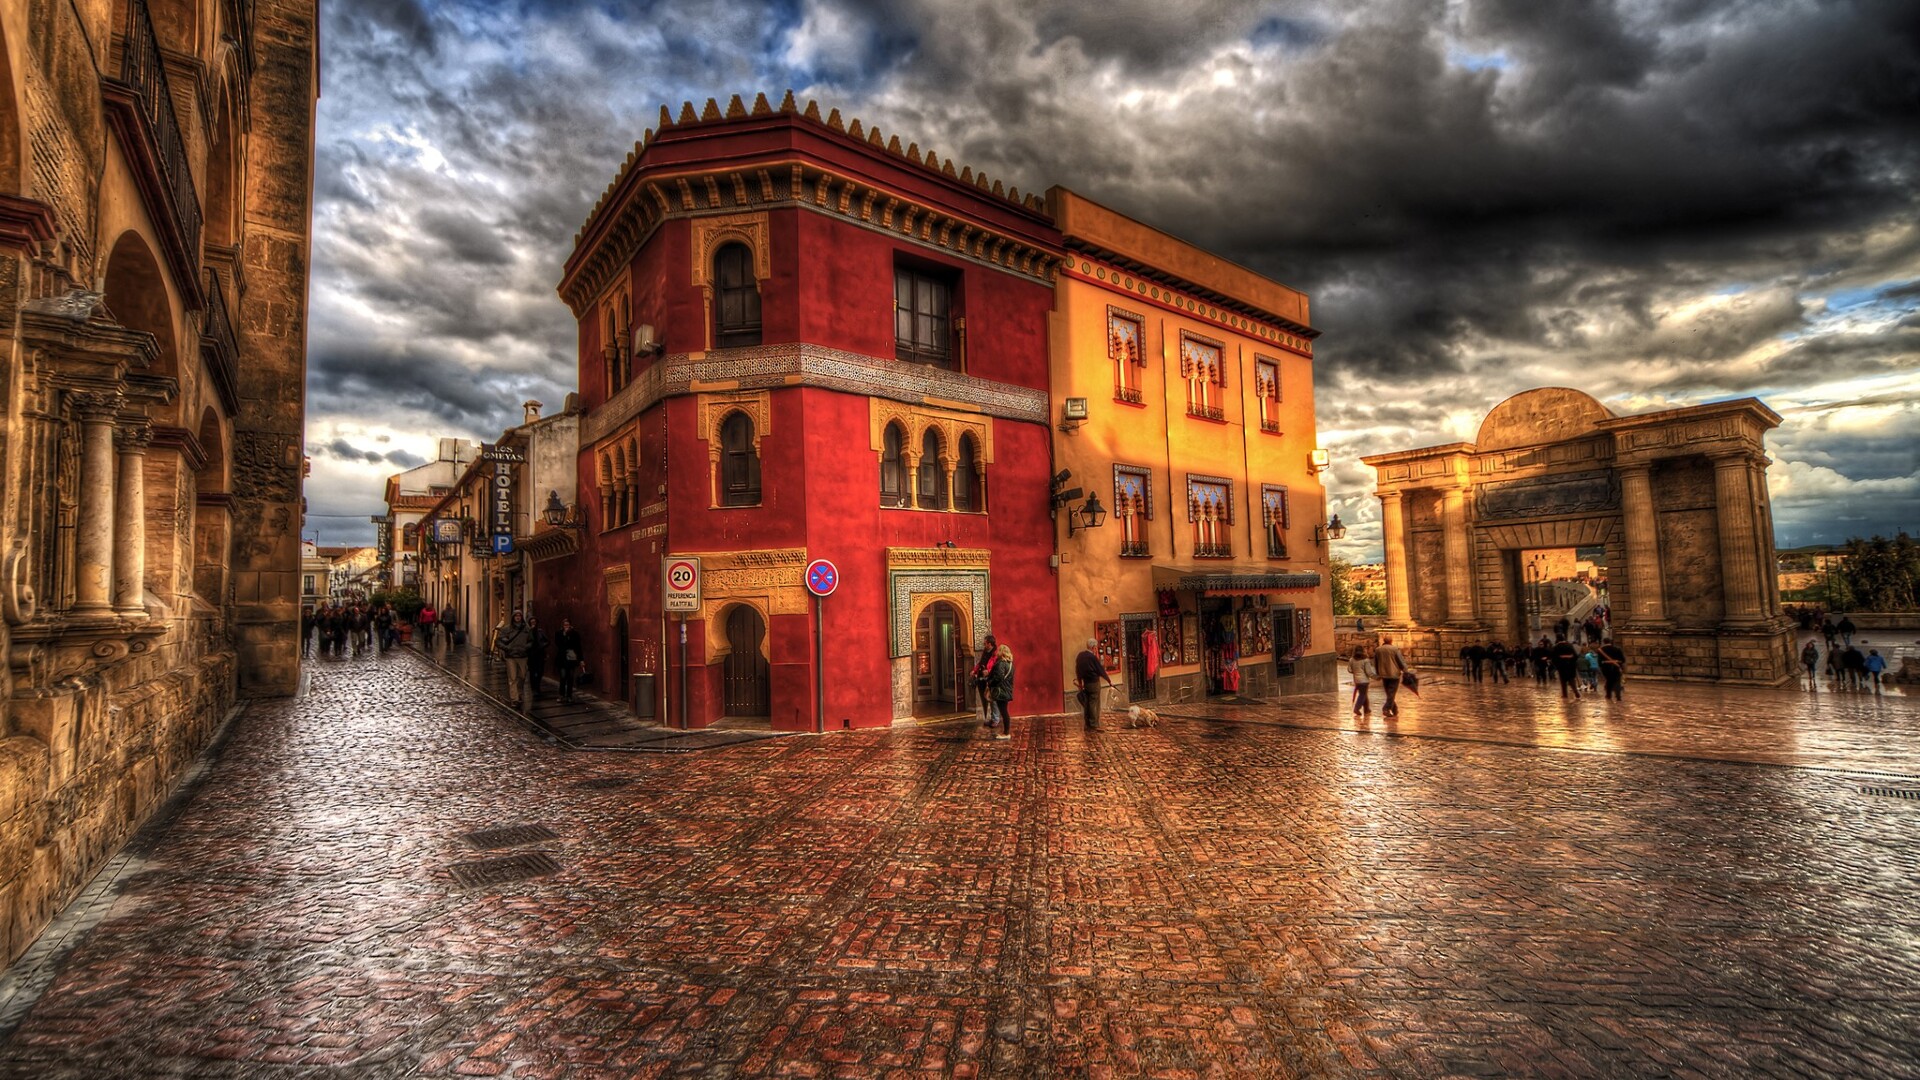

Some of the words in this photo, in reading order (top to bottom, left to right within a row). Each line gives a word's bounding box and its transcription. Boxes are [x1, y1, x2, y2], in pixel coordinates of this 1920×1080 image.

[483, 452, 524, 460] OMEYAS
[496, 463, 511, 525] HOTEL
[499, 537, 509, 549] P
[673, 571, 690, 581] 20
